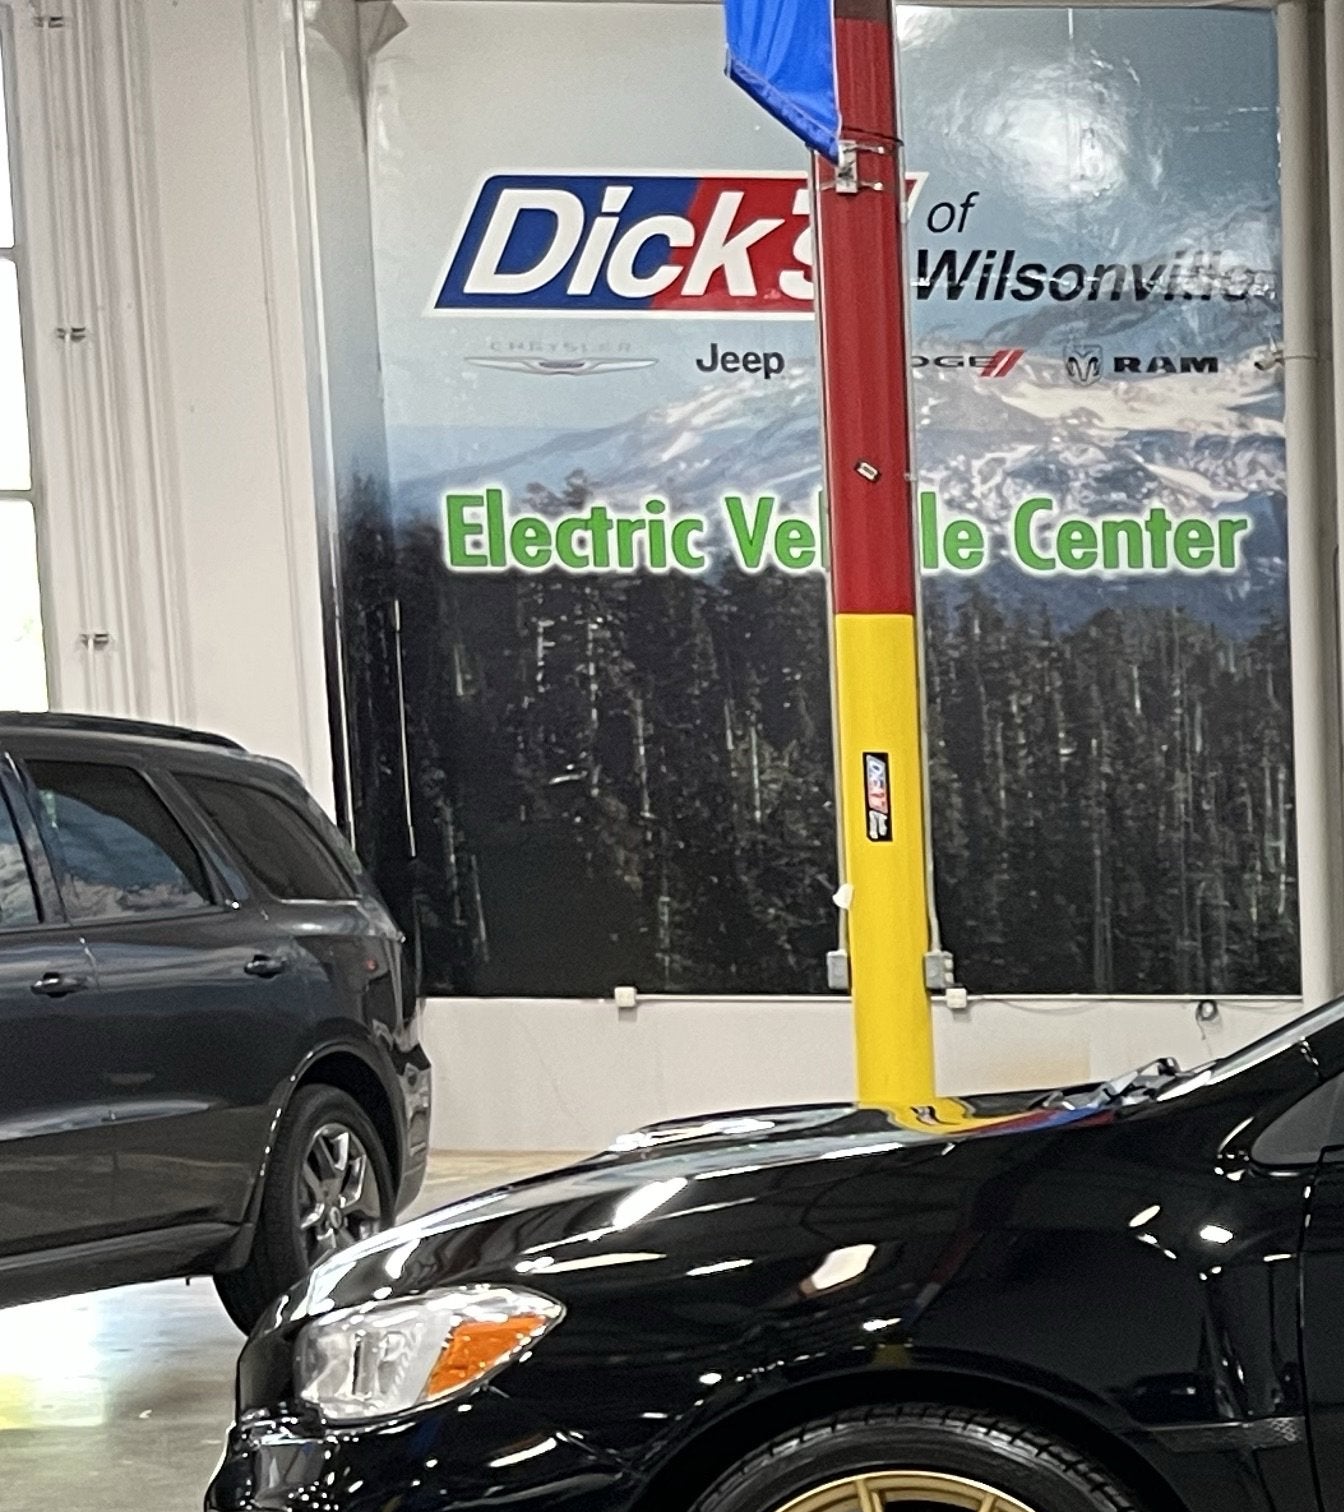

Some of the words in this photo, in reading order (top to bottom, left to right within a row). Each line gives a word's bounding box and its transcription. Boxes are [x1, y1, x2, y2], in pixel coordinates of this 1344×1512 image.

[927, 191, 980, 233] of
[696, 342, 786, 380] Jeep
[911, 355, 996, 369] DGE
[1113, 356, 1219, 373] RAM
[446, 488, 705, 569] Electric
[725, 490, 985, 571] Vele
[1013, 498, 1248, 571] Center
